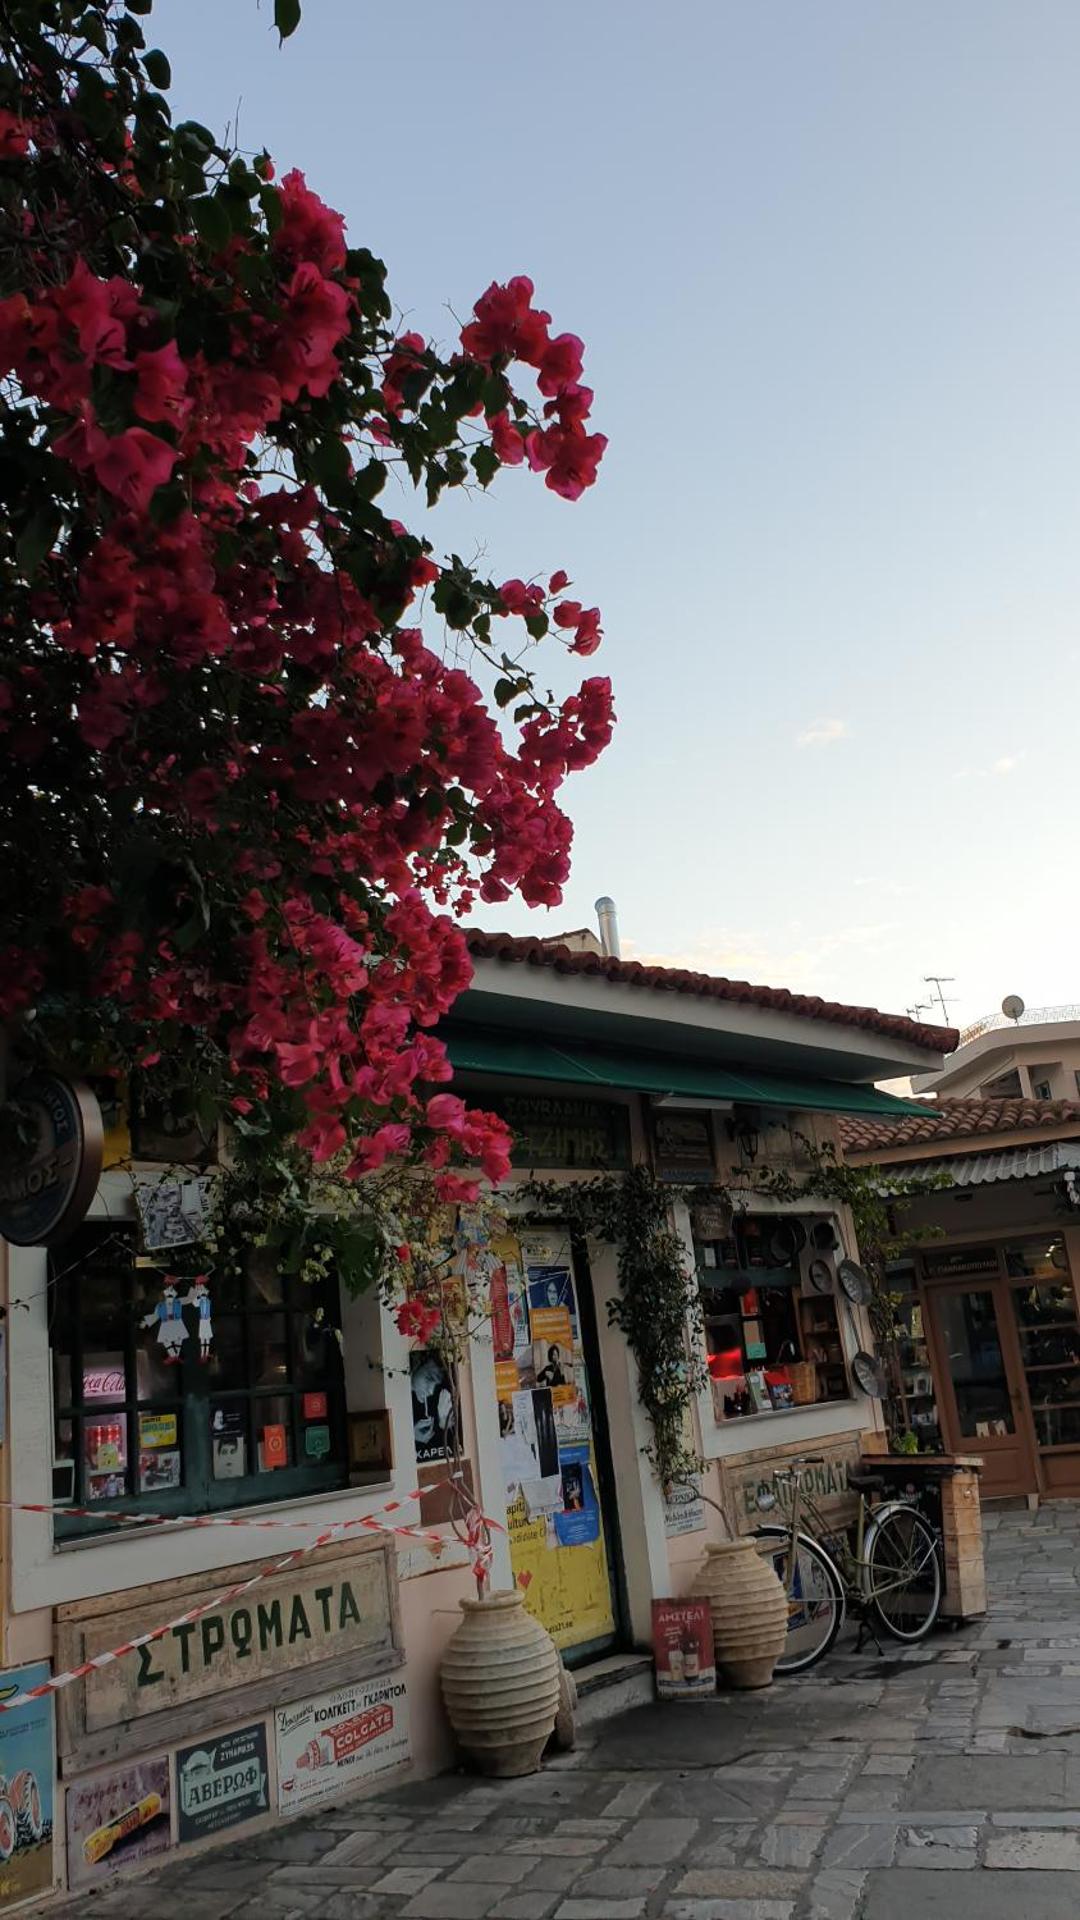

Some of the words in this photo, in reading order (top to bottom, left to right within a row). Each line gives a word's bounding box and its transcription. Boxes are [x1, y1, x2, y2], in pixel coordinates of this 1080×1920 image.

[137, 1582, 361, 1687] ΣΤΡΩΜΑΤΑ
[314, 1699, 356, 1723] ΚΟΛΓΚΕΤΤ
[363, 1683, 407, 1708] ΓΚΑΡΝΤΟΛ
[336, 1713, 392, 1749] COLGATE
[187, 1765, 258, 1809] ΑΒΕΡΩΦ
